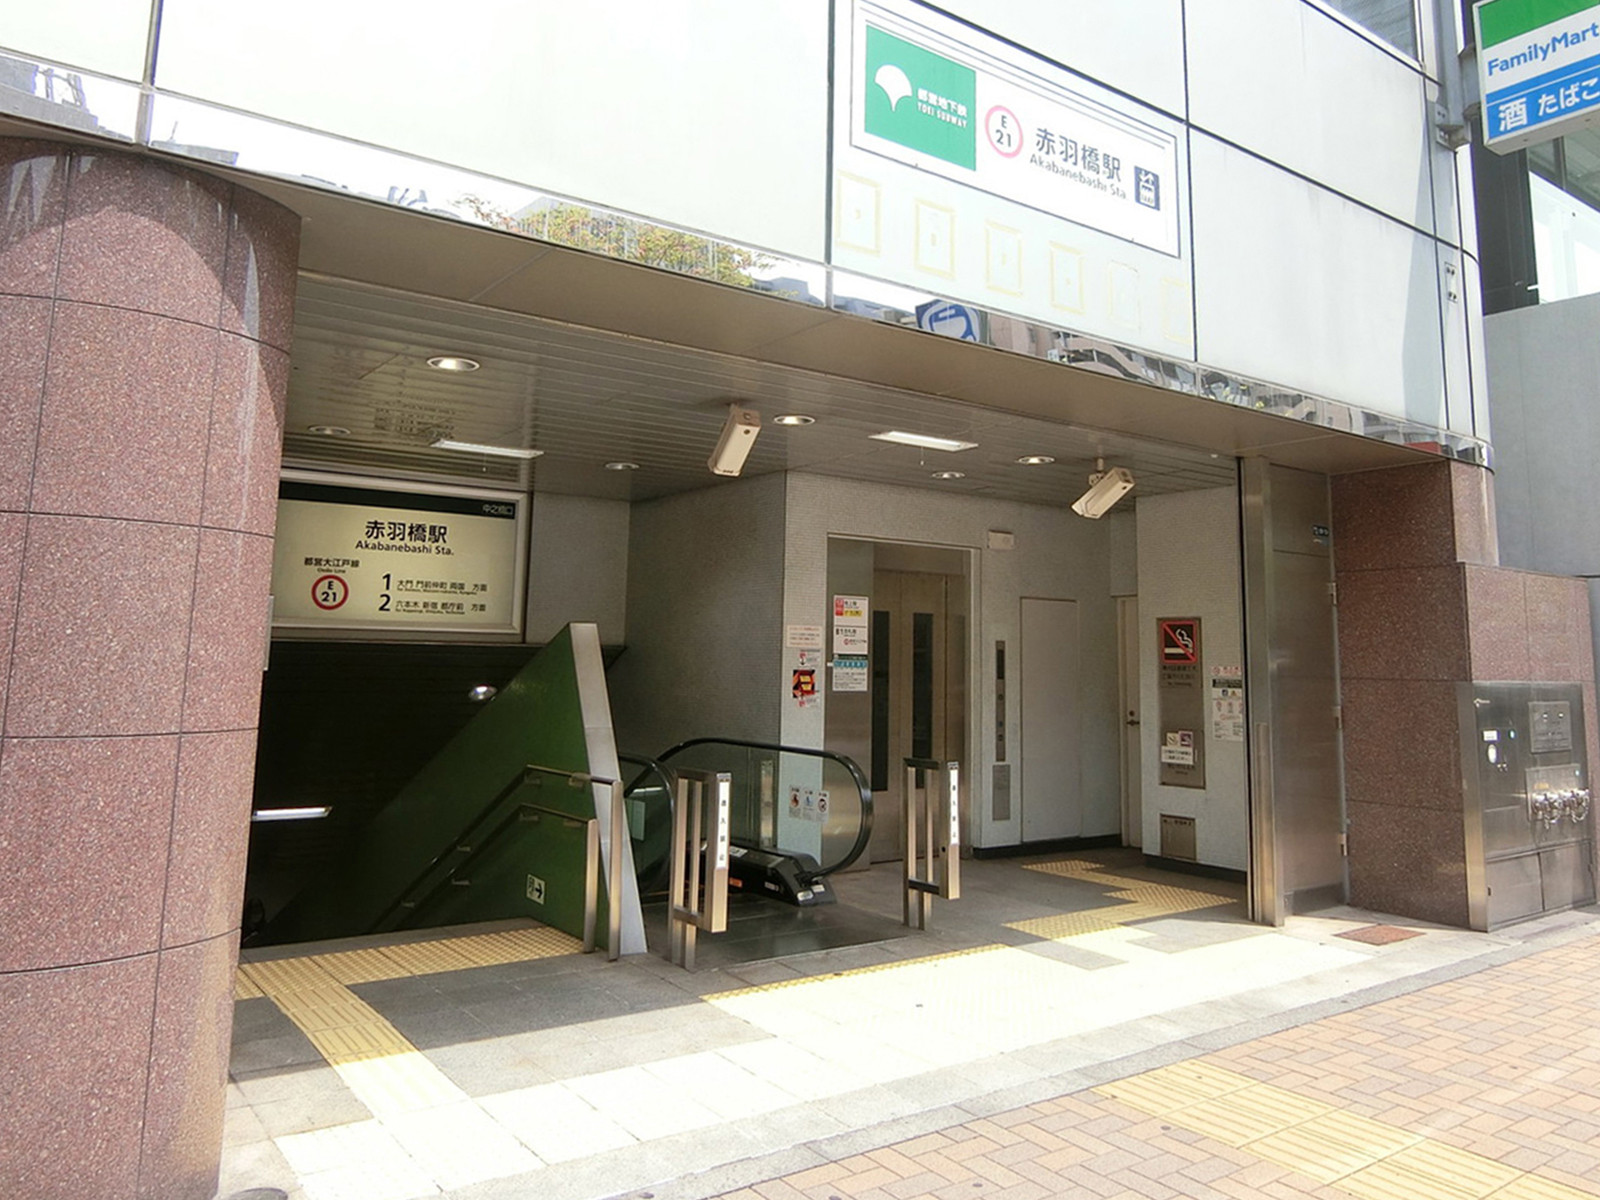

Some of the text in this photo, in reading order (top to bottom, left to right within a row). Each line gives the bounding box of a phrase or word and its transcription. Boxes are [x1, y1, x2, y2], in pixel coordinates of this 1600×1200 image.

[1487, 22, 1600, 76] FamilyMart
[1498, 77, 1600, 132] 酒 たばこ
[1000, 115, 1008, 129] E
[995, 129, 1012, 148] 21
[1035, 127, 1121, 182] 赤羽橋駅
[1029, 153, 1107, 192] Akabanebashi
[365, 520, 448, 544] 赤羽橋駅
[355, 540, 455, 556] Akabanebashi Sta.
[327, 580, 334, 590] E
[382, 573, 391, 591] 1
[321, 591, 337, 602] 21
[378, 594, 391, 611] 2
